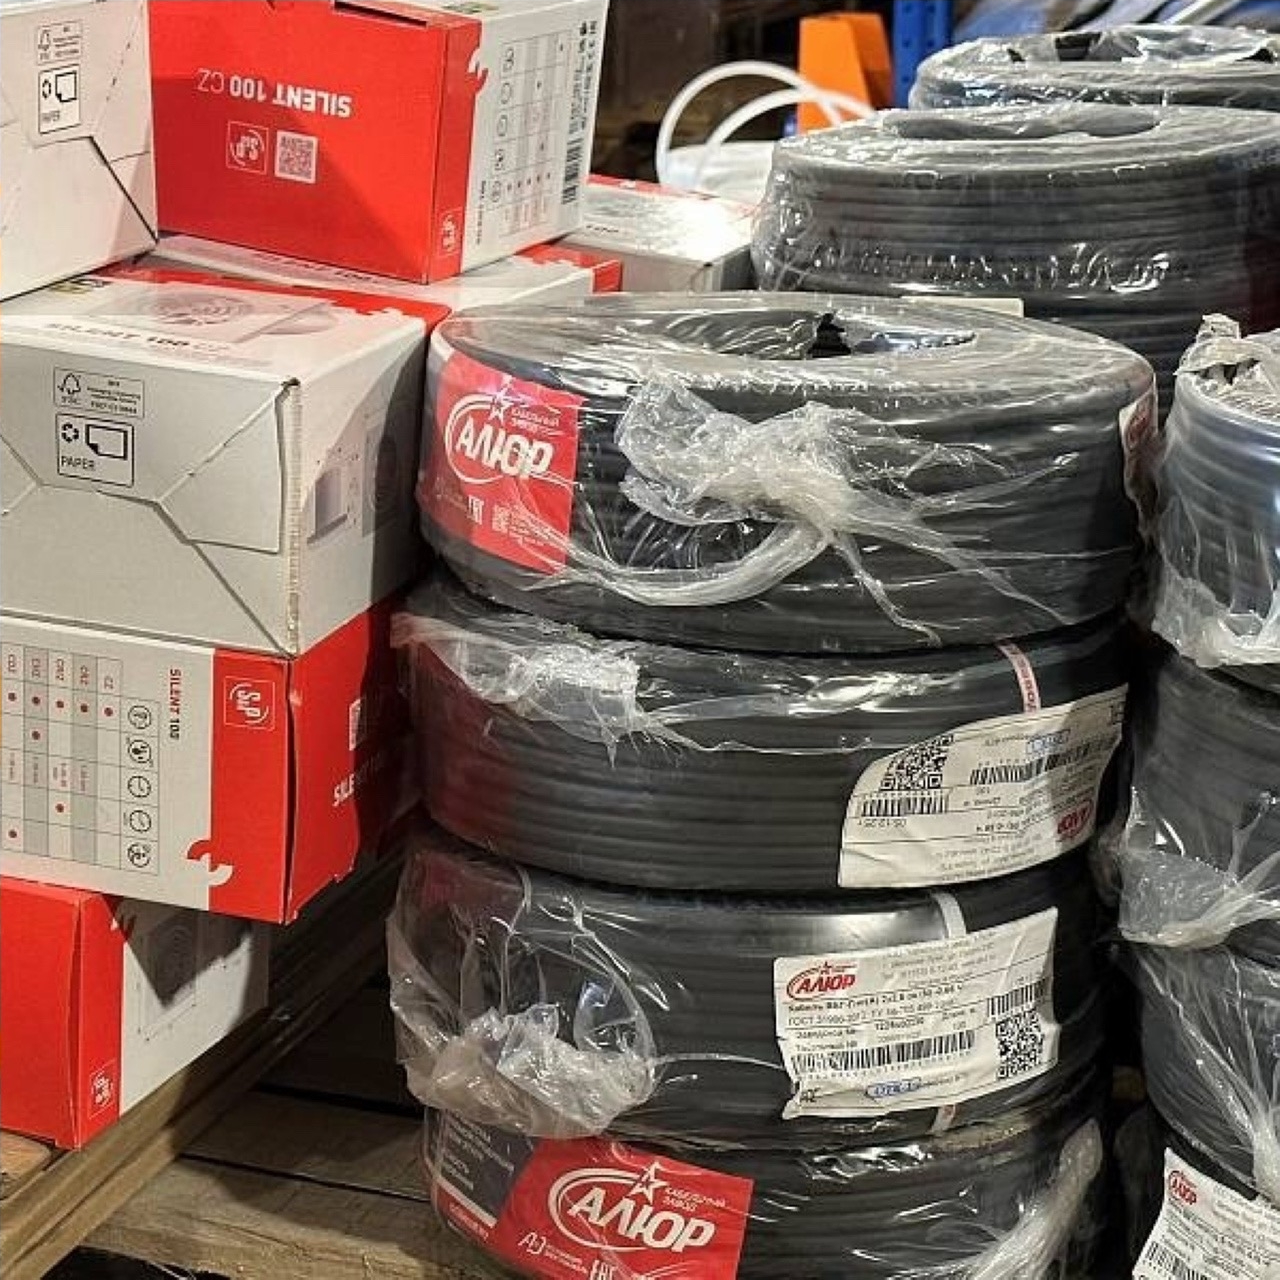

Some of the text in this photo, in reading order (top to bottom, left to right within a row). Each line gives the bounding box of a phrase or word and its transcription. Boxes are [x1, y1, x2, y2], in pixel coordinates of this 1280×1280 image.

[196, 67, 353, 118] SILENT 100 CZ
[61, 455, 96, 471] PAPER
[169, 668, 182, 715] SILENT
[795, 974, 856, 995] АЛЮР
[568, 1187, 716, 1253] АЛЮР
